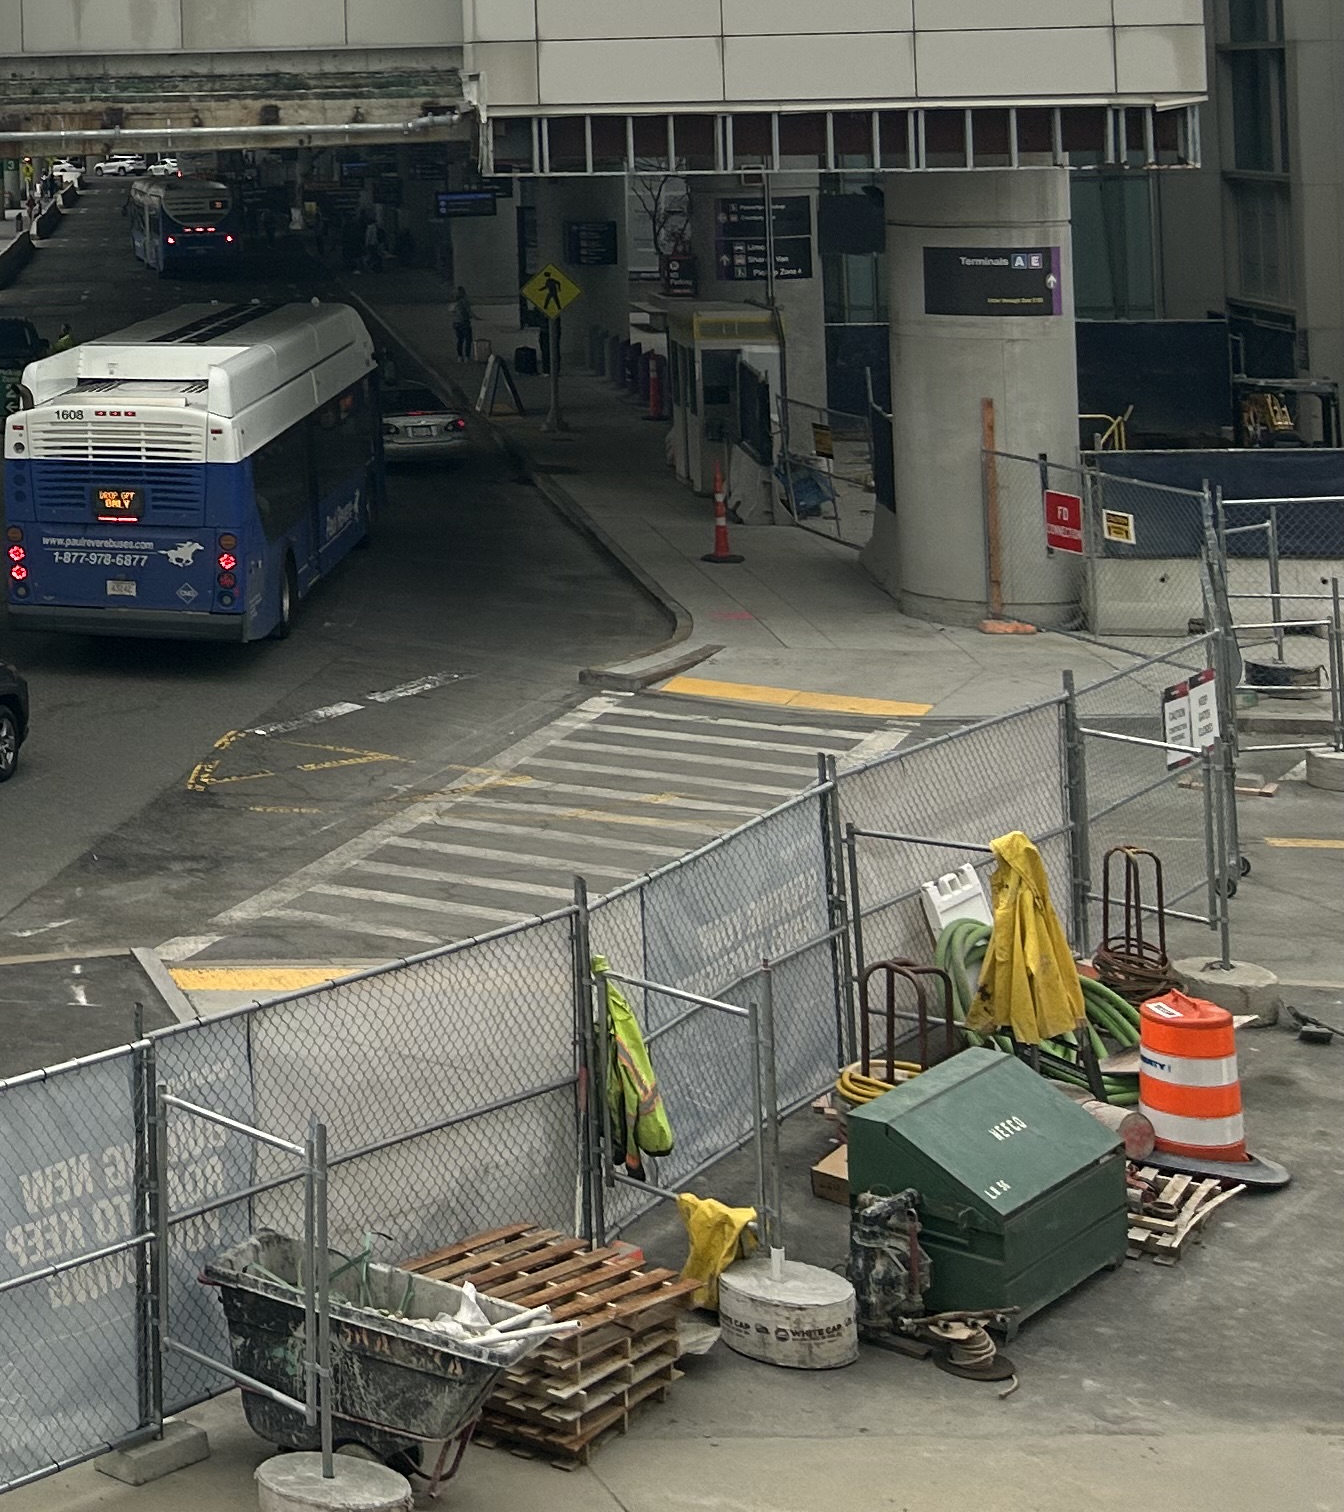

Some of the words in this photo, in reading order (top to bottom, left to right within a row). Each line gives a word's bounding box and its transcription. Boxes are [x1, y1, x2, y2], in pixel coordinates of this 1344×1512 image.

[959, 256, 1009, 266] Terminals
[1014, 256, 1025, 267] A
[1030, 255, 1040, 267] E
[54, 409, 84, 420] 1608
[42, 537, 154, 550] www.paulreverebuses.com
[53, 551, 148, 567] 1-877-978-6877
[988, 1115, 1028, 1141] NEFCO
[791, 1328, 824, 1338] WHITE
[825, 1323, 842, 1334] CAP
